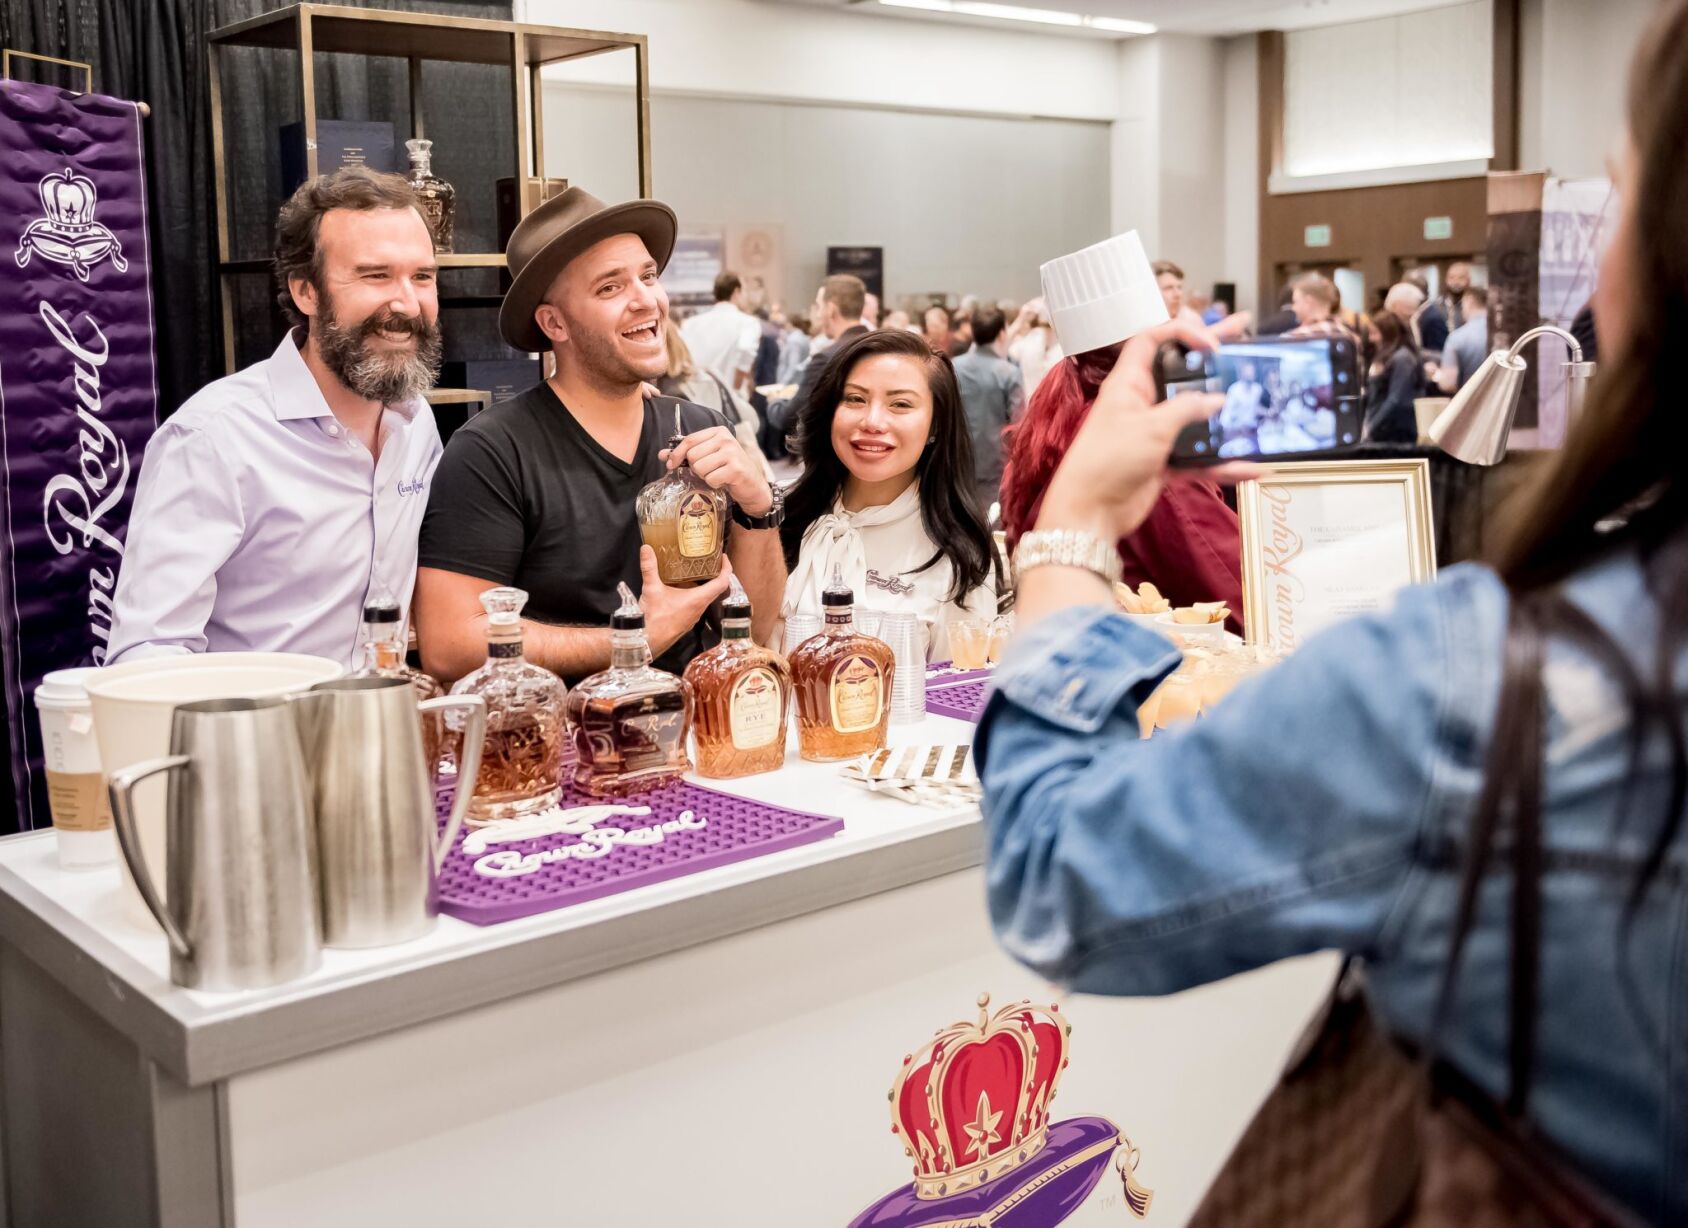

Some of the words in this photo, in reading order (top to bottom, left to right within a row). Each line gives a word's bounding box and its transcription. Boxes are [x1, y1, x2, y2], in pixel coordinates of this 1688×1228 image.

[39, 300, 130, 557] Royal
[1259, 484, 1304, 602] Royal
[745, 711, 766, 723] RYE
[473, 842, 597, 878] Crown
[573, 809, 707, 859] Royal
